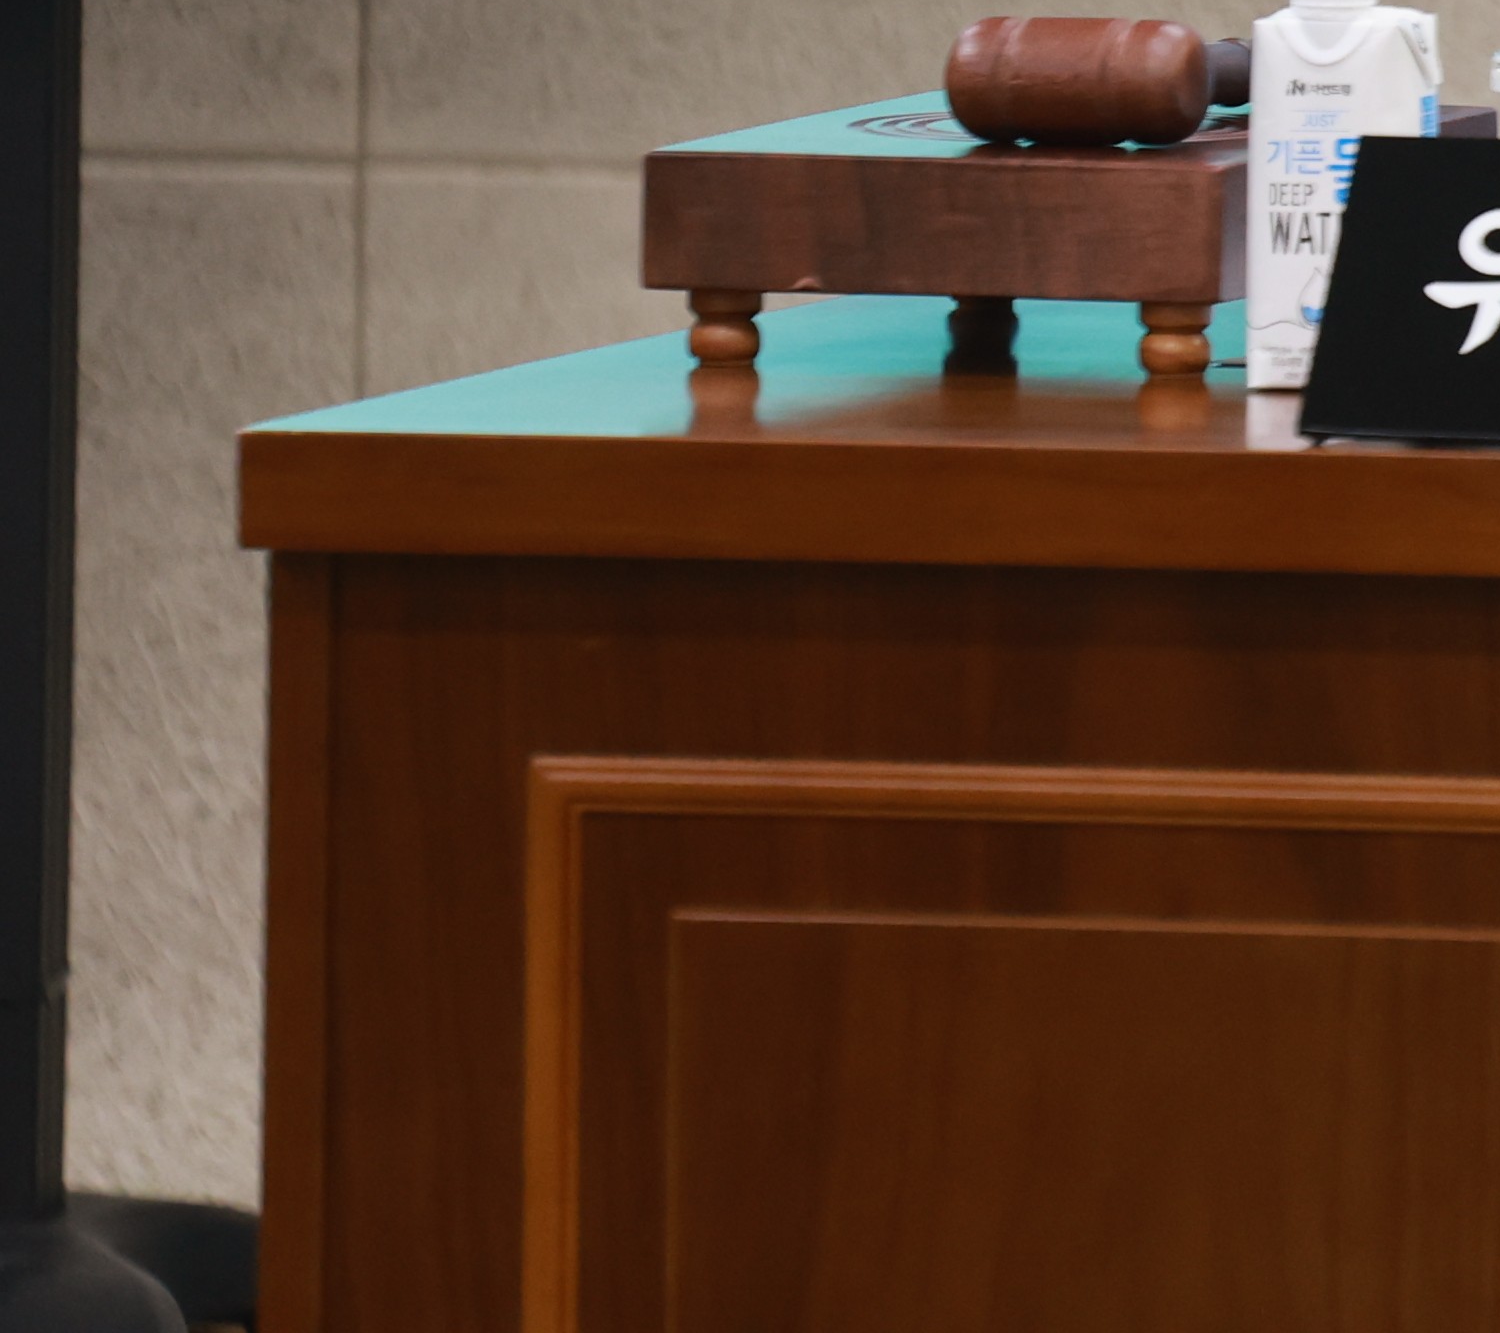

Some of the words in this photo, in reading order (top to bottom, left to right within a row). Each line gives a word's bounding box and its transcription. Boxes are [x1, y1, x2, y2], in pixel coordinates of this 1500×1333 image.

[1301, 113, 1338, 128] JUST
[1266, 139, 1324, 175] 기픈
[1267, 183, 1315, 207] DEEP
[1268, 211, 1333, 255] WAT
